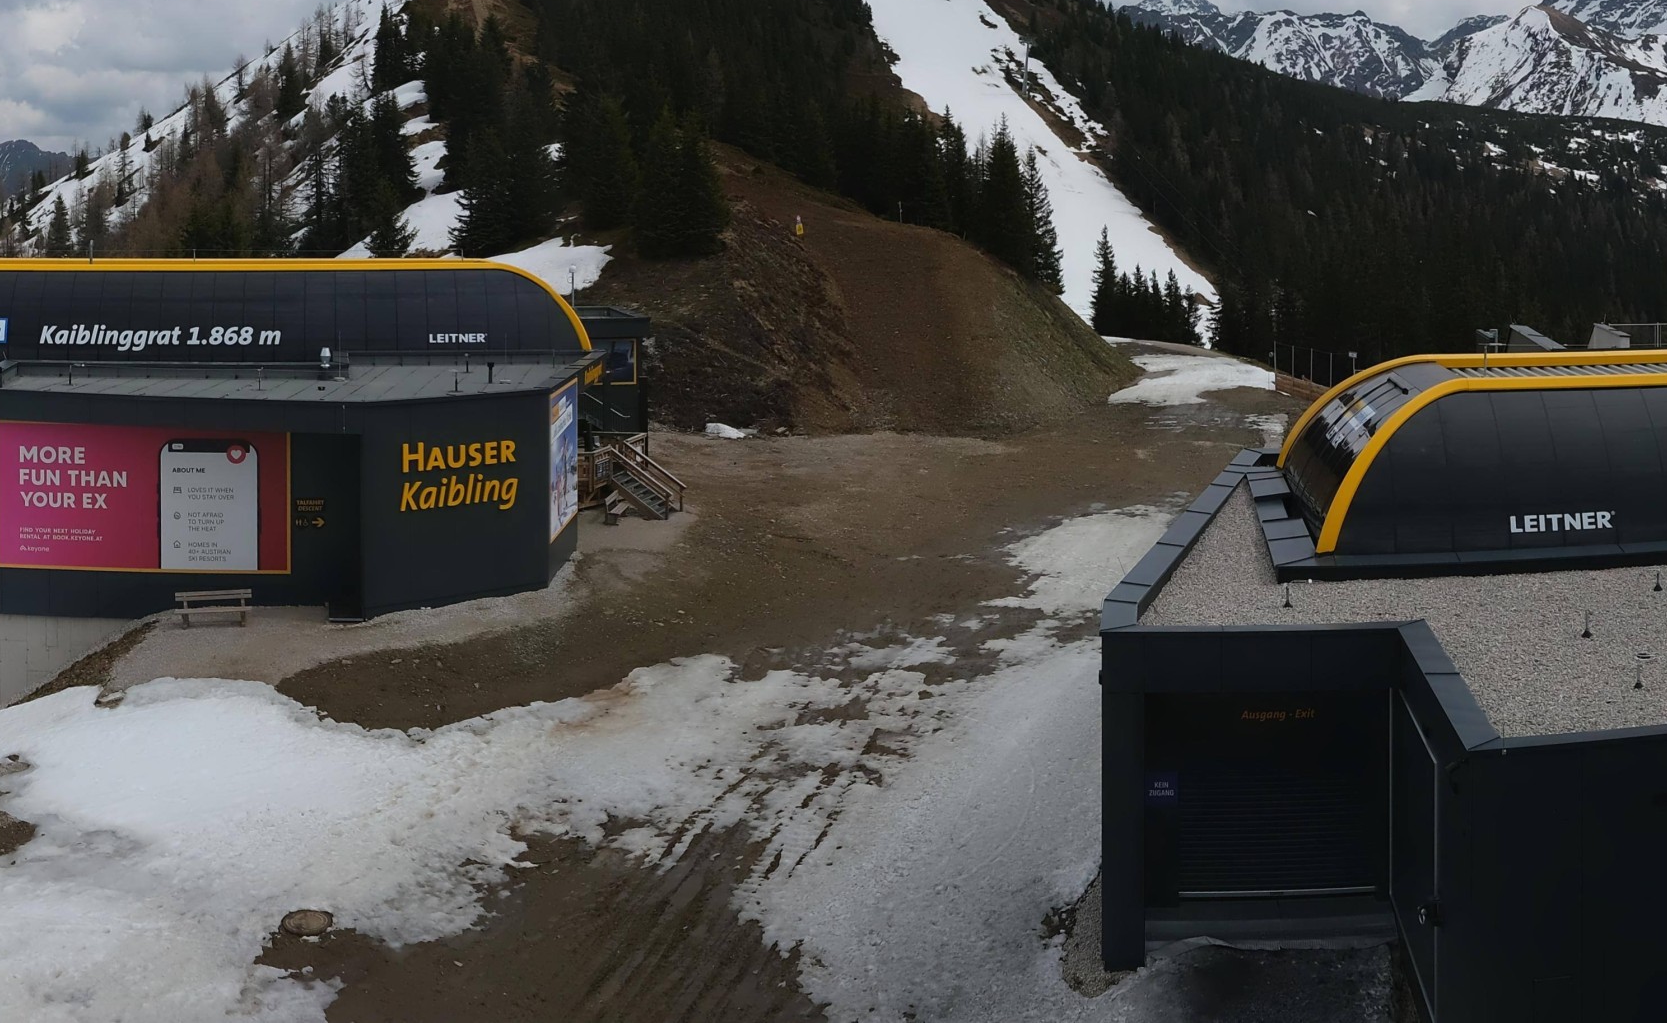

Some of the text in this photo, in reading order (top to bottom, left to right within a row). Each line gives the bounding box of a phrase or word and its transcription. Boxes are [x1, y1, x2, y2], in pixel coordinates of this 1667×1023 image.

[39, 324, 282, 352] Kaiblinggrat 1.868 m
[429, 333, 485, 344] LEITNER
[19, 446, 86, 464] MORE
[19, 468, 127, 487] FUN THAN
[20, 491, 108, 509] YOUR EX
[400, 473, 518, 512] Kaibling
[1509, 511, 1613, 533] LEITNER
[27, 545, 50, 553] keyone
[1240, 710, 1286, 722] Ausgang
[1295, 708, 1316, 719] Exit
[1149, 789, 1175, 797] ZUGANG
[1154, 781, 1169, 789] KEIN
